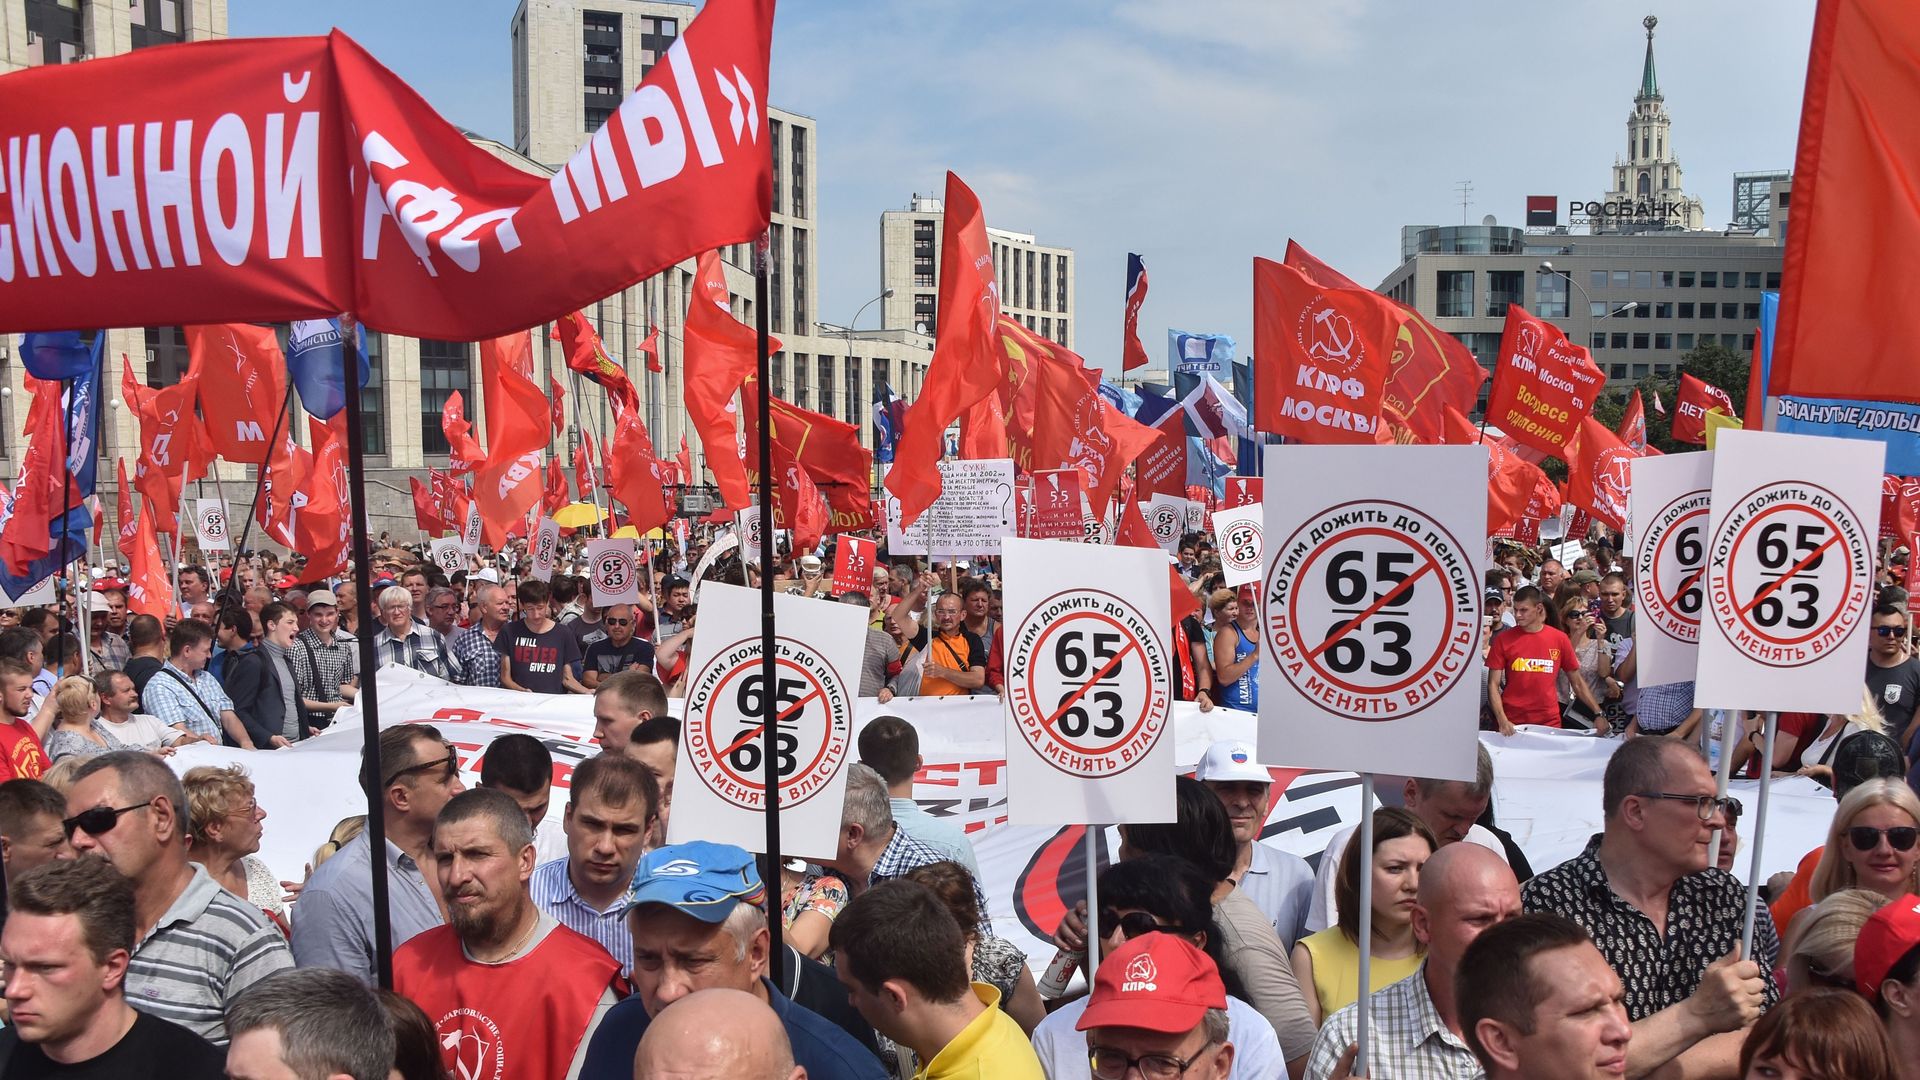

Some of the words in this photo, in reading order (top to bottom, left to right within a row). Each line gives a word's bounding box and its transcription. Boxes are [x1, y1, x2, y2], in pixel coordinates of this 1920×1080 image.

[1570, 201, 1681, 217] РОСБАНК
[1652, 218, 1681, 226] GROUP
[1296, 364, 1365, 400] КПРФ
[1678, 401, 1705, 419] ДЕТ
[207, 515, 221, 523] 65
[208, 526, 221, 534] 63
[470, 527, 477, 538] 63
[471, 517, 480, 527] 65
[1156, 524, 1171, 536] 63
[1158, 512, 1174, 524] 65
[1712, 513, 1746, 568] Хотим
[1746, 489, 1808, 517] дожить
[1811, 494, 1832, 512] до
[1833, 509, 1867, 578] пенсии!
[443, 552, 456, 560] 65
[1232, 530, 1253, 546] 65
[1235, 545, 1256, 561] 63
[1640, 525, 1663, 573] Хотим
[1675, 526, 1703, 566] 6
[1756, 522, 1825, 572] 65
[445, 560, 458, 569] 63
[602, 559, 622, 572] 65
[848, 554, 865, 567] 55
[1270, 541, 1309, 606] Хотим
[1309, 510, 1388, 545] дожить
[1393, 514, 1421, 534] до
[1423, 531, 1474, 613] пенсии!
[1325, 550, 1415, 607] 65
[604, 573, 623, 586] 63
[1677, 574, 1703, 614] 6
[1641, 579, 1665, 623] ПОРА
[1666, 618, 1698, 639] МЕН
[1712, 576, 1736, 630] ПОРА
[1735, 629, 1806, 662] МЕНЯТЬ
[1811, 583, 1866, 655] ВЛАСТЬ!
[1752, 580, 1820, 630] 63
[514, 646, 558, 664] NEVER
[515, 636, 520, 646] I
[520, 636, 537, 648] WILL
[1013, 622, 1041, 679] Хотим
[1040, 597, 1100, 626] дожить
[1104, 602, 1124, 619] до
[1127, 616, 1166, 683] пенсии!
[1055, 631, 1123, 680] 65
[1323, 619, 1412, 676] 63
[529, 662, 546, 673] GIVE
[546, 663, 556, 673] UP
[1271, 614, 1305, 678] ПОРА
[1304, 675, 1398, 714] МЕНЯТЬ
[1404, 622, 1473, 707] ВЛАСТЬ!
[691, 662, 726, 713] Хотим
[729, 644, 791, 667] дожть
[794, 651, 815, 668] до
[815, 666, 846, 731] пенсии!
[736, 674, 807, 722] 65
[1013, 687, 1044, 743] ПОРА
[1044, 740, 1117, 772] МЕНЯТЬ
[1120, 690, 1166, 763] ВЛАСТЬ!
[1056, 690, 1125, 738] 63
[690, 720, 713, 773] ПОРА
[788, 736, 844, 801] ВЛАСТЬ!
[729, 728, 799, 776] 63
[1122, 982, 1157, 992] КПРФ
